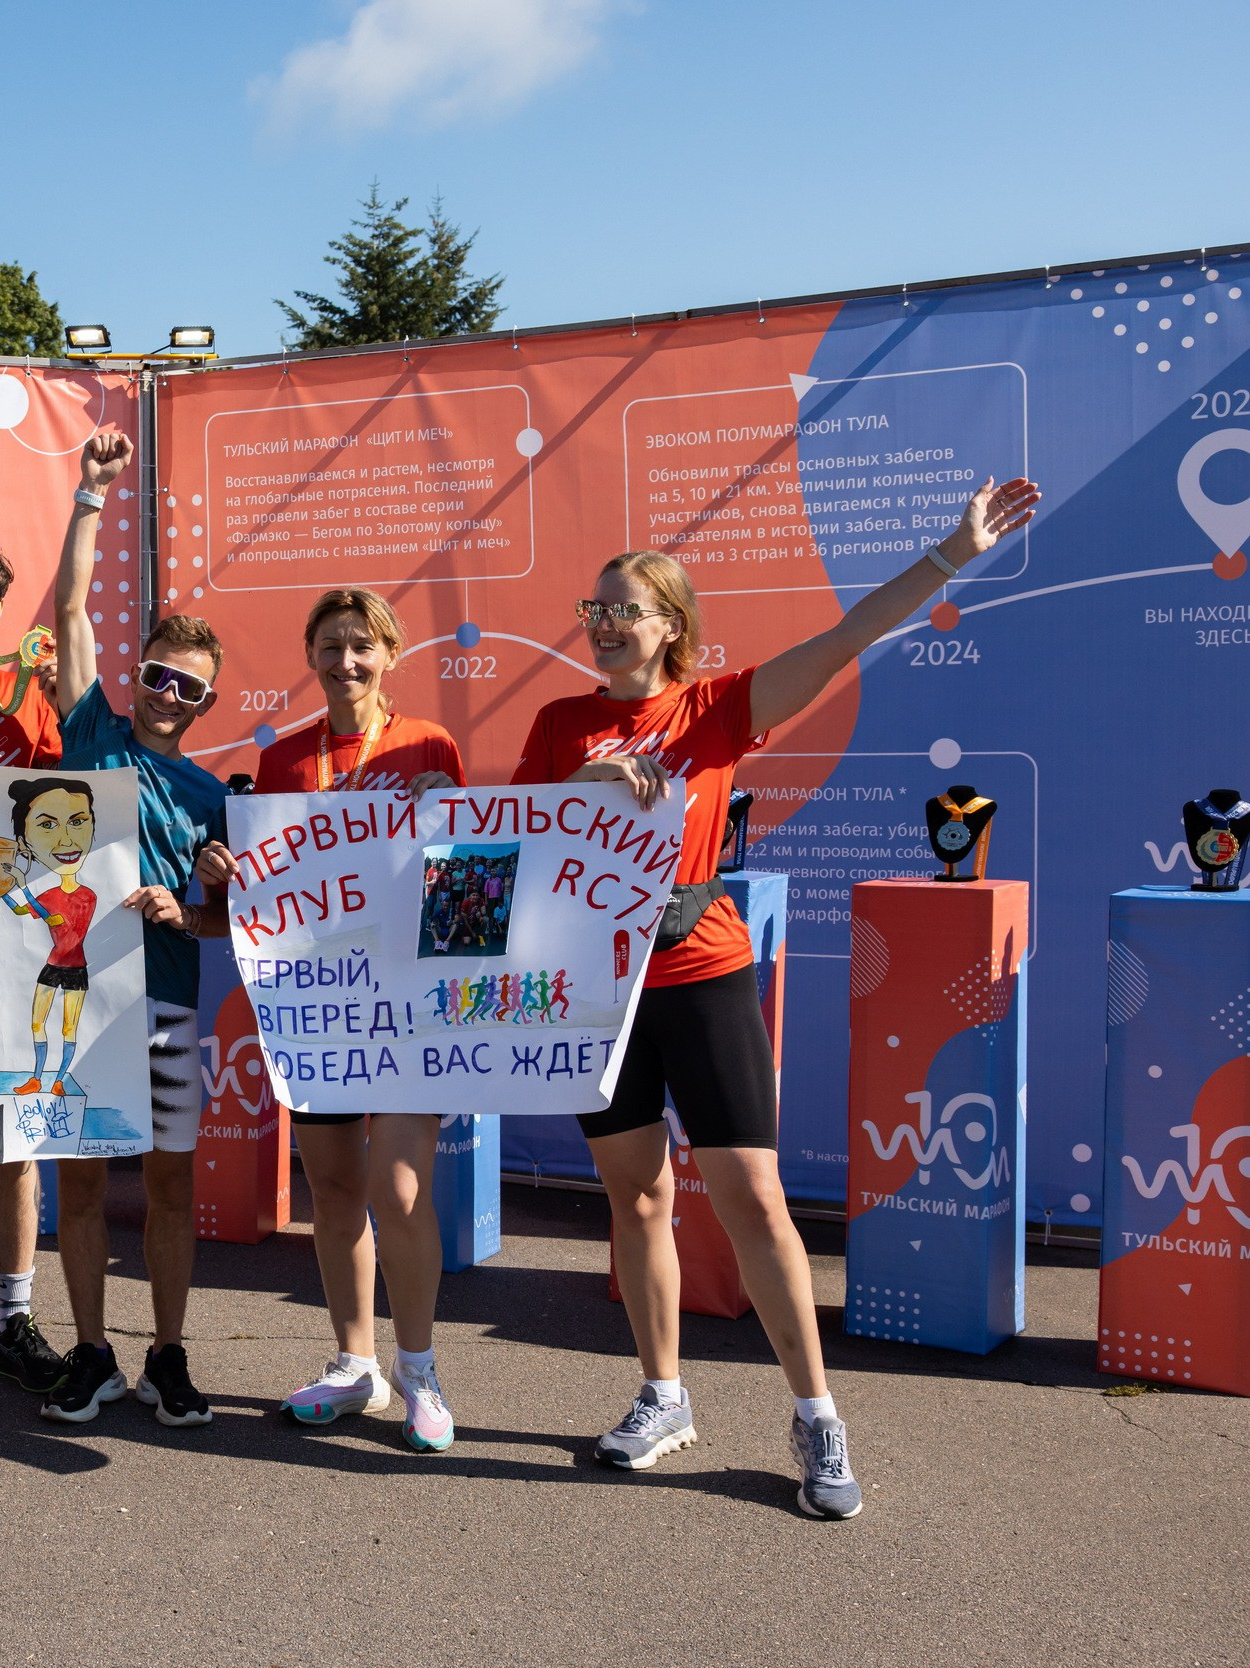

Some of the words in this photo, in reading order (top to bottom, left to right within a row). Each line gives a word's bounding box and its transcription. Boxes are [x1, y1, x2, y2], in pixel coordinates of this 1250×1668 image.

[224, 440, 290, 458] ТУЛЬСКИЙ
[294, 434, 358, 452] МАРАФОН
[366, 430, 401, 447] «ЩИТ
[406, 430, 415, 442] И
[418, 427, 454, 441] МЕЧ»
[645, 431, 710, 449] ЭВОКОМ
[716, 419, 841, 444] ПОЛУМАРАФОН
[847, 414, 889, 432] ТУЛА
[226, 469, 356, 488] Восстанавливаемся
[360, 468, 368, 478] и
[372, 462, 423, 480] растем,
[427, 458, 495, 474] несмотря
[648, 466, 728, 483] Обновили
[734, 462, 791, 482] трассы
[796, 454, 879, 473] основных
[884, 446, 954, 464] забегов
[226, 495, 240, 507] на
[245, 488, 324, 506] глобальные
[328, 483, 410, 502] потрясения.
[414, 474, 494, 494] Последний
[650, 492, 668, 504] на
[672, 487, 685, 504] 5,
[690, 486, 706, 502] 10
[712, 488, 720, 499] и
[726, 484, 741, 499] 21
[746, 484, 770, 498] км.
[776, 474, 866, 495] Увеличили
[872, 468, 974, 488] количество
[226, 514, 248, 527] раз
[252, 510, 308, 526] провели
[312, 506, 349, 520] забег
[354, 506, 361, 517] в
[366, 503, 417, 516] составе
[421, 500, 464, 514] серии
[649, 508, 745, 526] участников,
[750, 502, 796, 518] снова
[802, 496, 891, 516] двигаемся
[897, 495, 906, 507] к
[226, 529, 290, 546] «Фармэко
[312, 524, 352, 538] Бегом
[356, 525, 372, 536] по
[376, 520, 441, 537] Золотому
[446, 516, 502, 533] кольцу»
[650, 529, 751, 546] показателям
[757, 528, 766, 538] в
[771, 521, 840, 541] истории
[844, 514, 906, 532] забега.
[912, 514, 962, 533] Встре
[227, 552, 235, 563] и
[239, 546, 329, 565] попрощались
[333, 546, 340, 556] с
[344, 541, 418, 556] названием
[422, 538, 459, 554] «Щит
[464, 539, 472, 550] и
[476, 536, 510, 549] меч»
[670, 549, 701, 564] стей
[706, 548, 724, 562] из
[729, 546, 738, 561] 3
[743, 546, 788, 563] стран
[794, 546, 804, 558] и
[809, 541, 827, 557] 36
[832, 538, 914, 559] регионов
[1145, 608, 1172, 624] ВЫ
[1181, 604, 1250, 623] НАХОД
[440, 656, 497, 679] 2022
[696, 644, 726, 668] 23
[910, 640, 981, 666] 2024
[240, 690, 290, 712] 2021
[736, 787, 846, 800] ЛУМАРАФОН
[853, 787, 894, 801] ТУЛА
[234, 788, 417, 892] ПЕРВЫЙ
[439, 796, 682, 885] ТУЛЬСКИЙ
[746, 825, 817, 836] менения
[823, 822, 882, 837] забега:
[888, 822, 928, 840] убир
[746, 844, 767, 858] 2,2
[772, 848, 792, 856] км
[798, 848, 807, 857] и
[812, 848, 892, 860] проводим
[896, 845, 936, 859] собы
[806, 889, 850, 900] моме
[238, 874, 367, 946] КЛУБ
[786, 907, 851, 924] умарфо
[239, 949, 380, 991] ПЕРВЫЙ,
[260, 998, 415, 1039] ВПЕРЁД!
[423, 1043, 492, 1077] ВАС
[510, 1036, 617, 1084] ЖДЁТ
[436, 1135, 481, 1155] МАРАФОН
[816, 1152, 849, 1163] насто
[861, 1191, 957, 1217] ТУЛЬСКИЙ
[964, 1197, 1010, 1220] МАРАФОН
[1122, 1232, 1232, 1259] ТУЛЬСКИЙ
